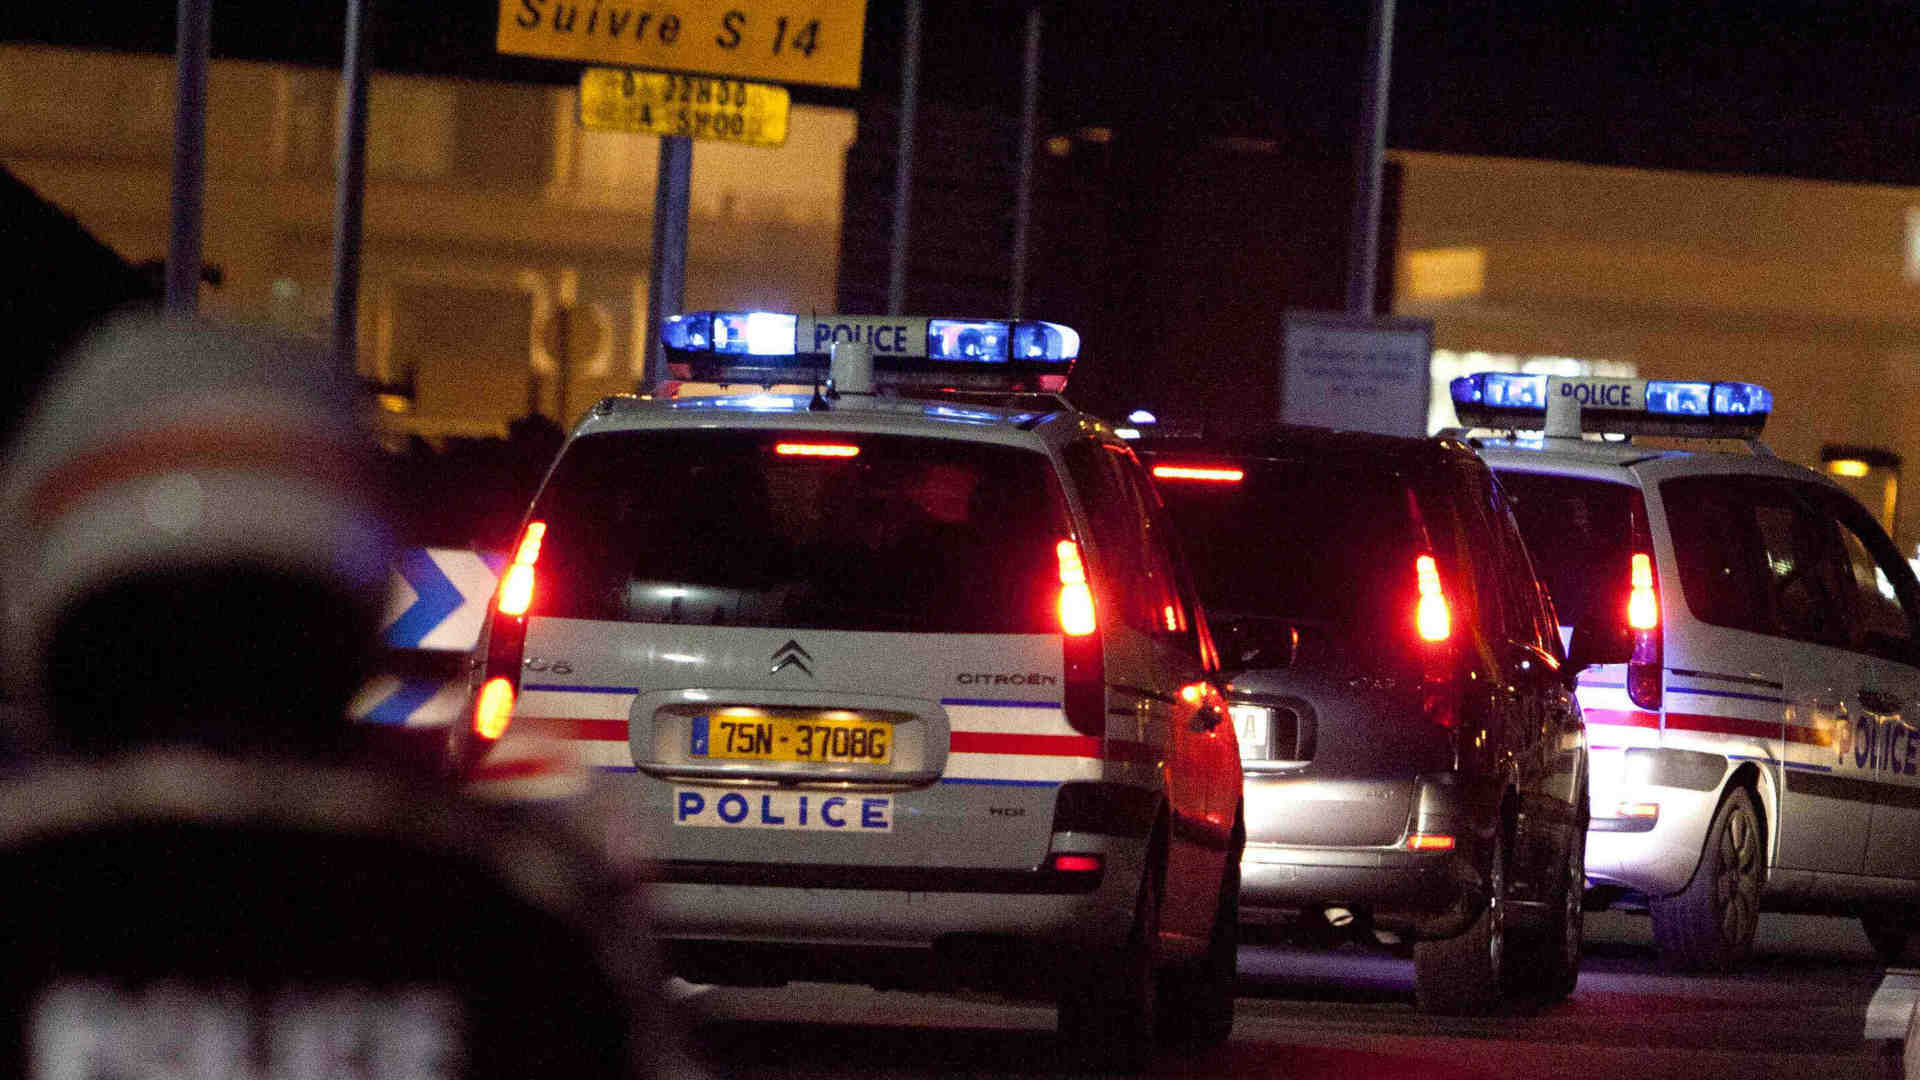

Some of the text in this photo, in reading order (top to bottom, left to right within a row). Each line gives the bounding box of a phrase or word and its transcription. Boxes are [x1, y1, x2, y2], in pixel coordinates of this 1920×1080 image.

[516, 0, 821, 58] Suivre S 14
[1561, 382, 1632, 407] POLICE
[678, 792, 890, 828] POLICE
